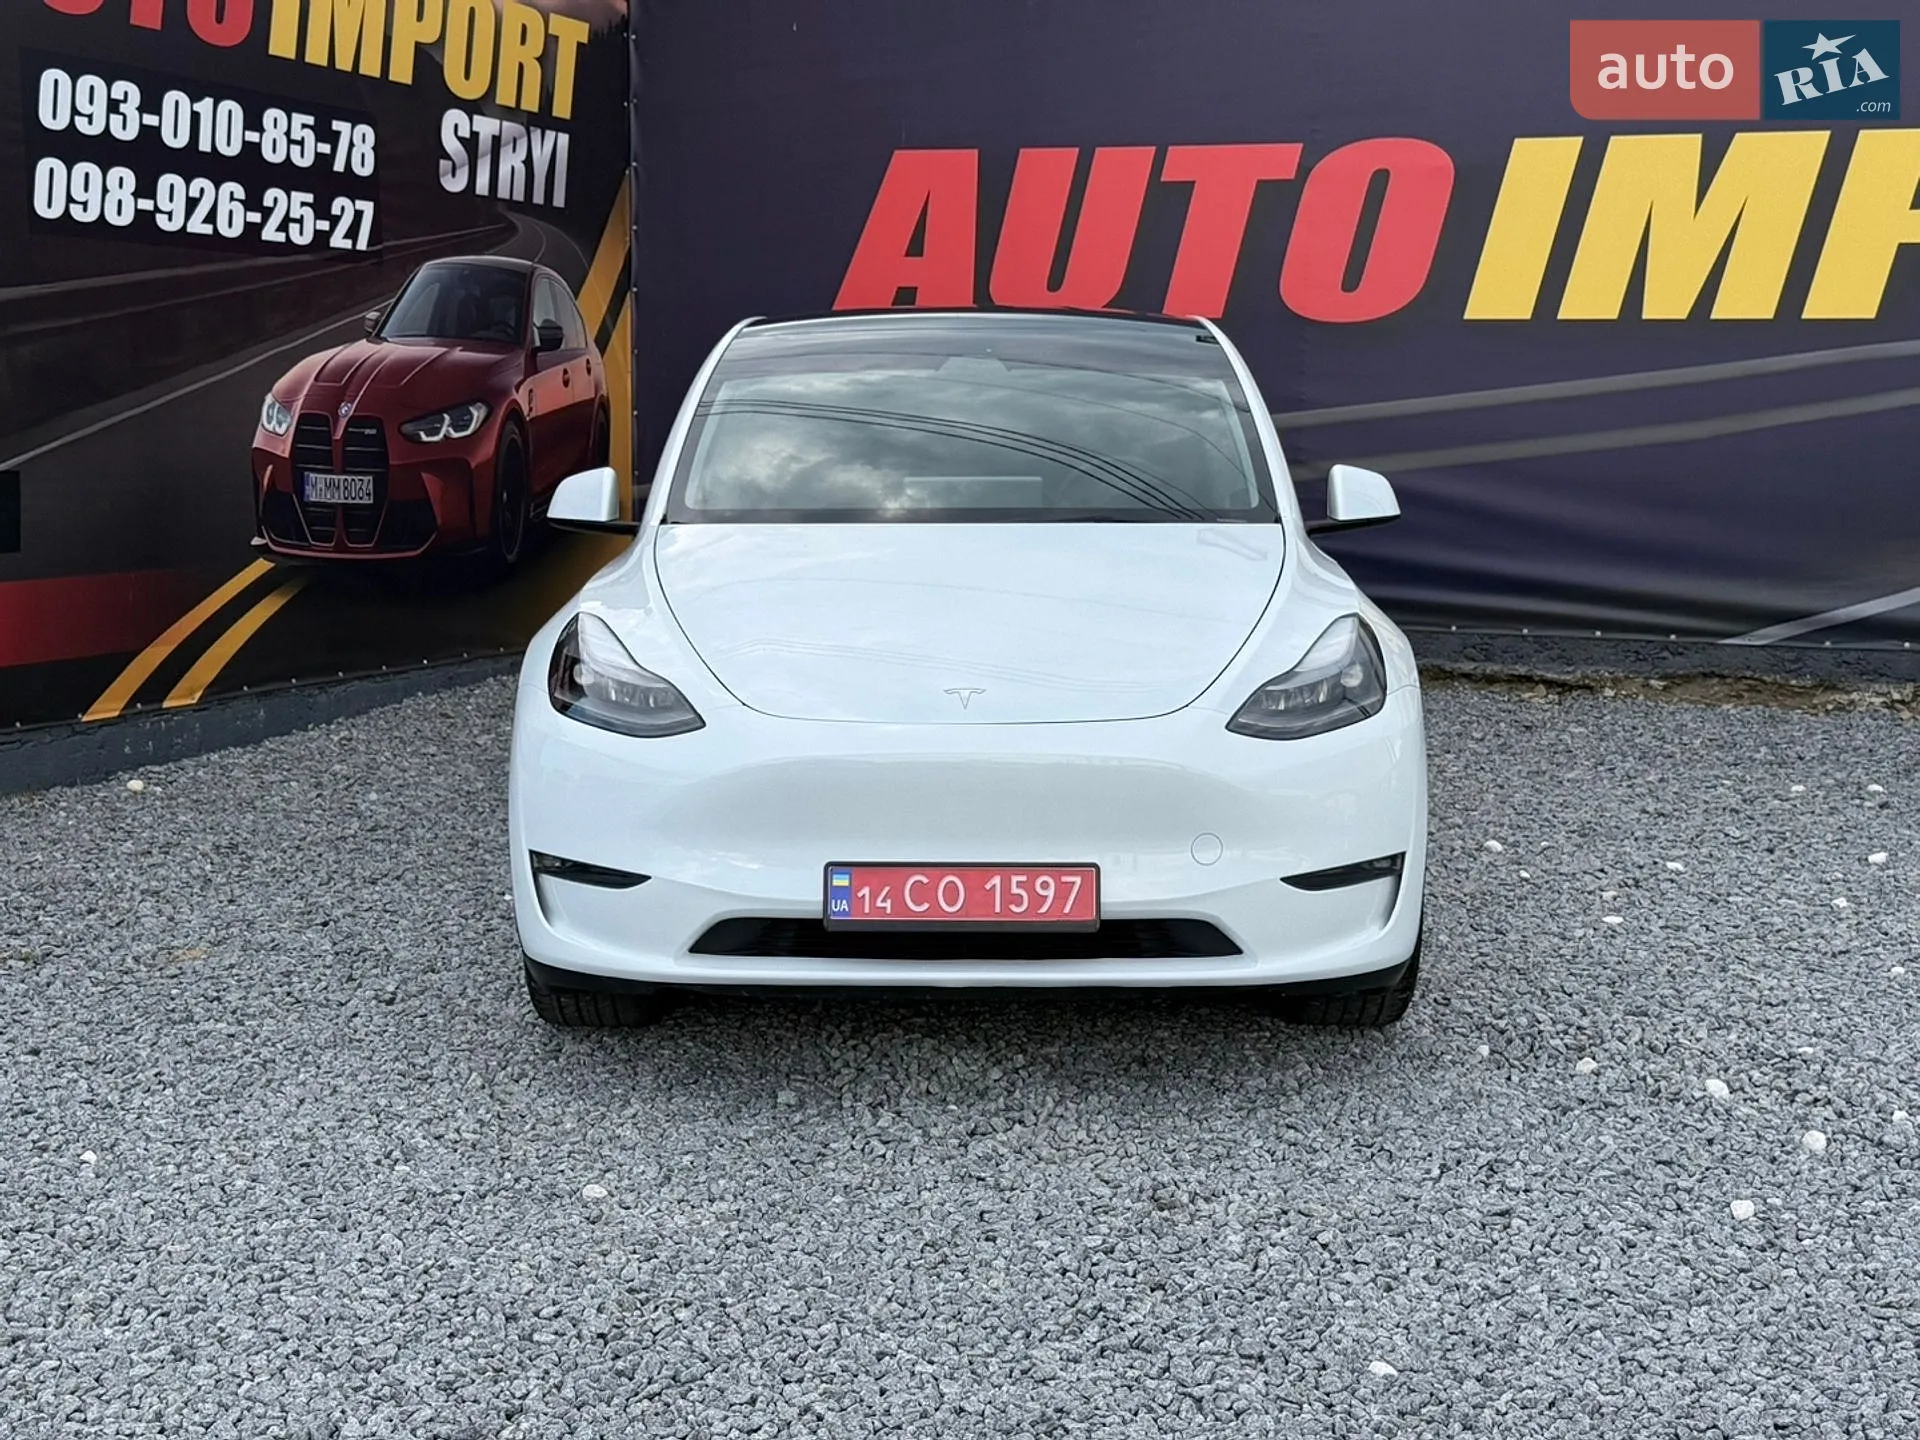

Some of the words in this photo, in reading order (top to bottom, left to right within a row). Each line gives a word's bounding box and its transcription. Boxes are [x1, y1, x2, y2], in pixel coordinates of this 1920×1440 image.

[38, 68, 376, 177] 093-010-85-78
[438, 108, 571, 208] STRYI
[33, 157, 375, 251] 098-926-25-27
[832, 137, 1456, 323] AUTO
[832, 900, 849, 913] UA
[857, 886, 892, 914] 14
[903, 874, 966, 914] CO
[984, 874, 1083, 914] 1597
